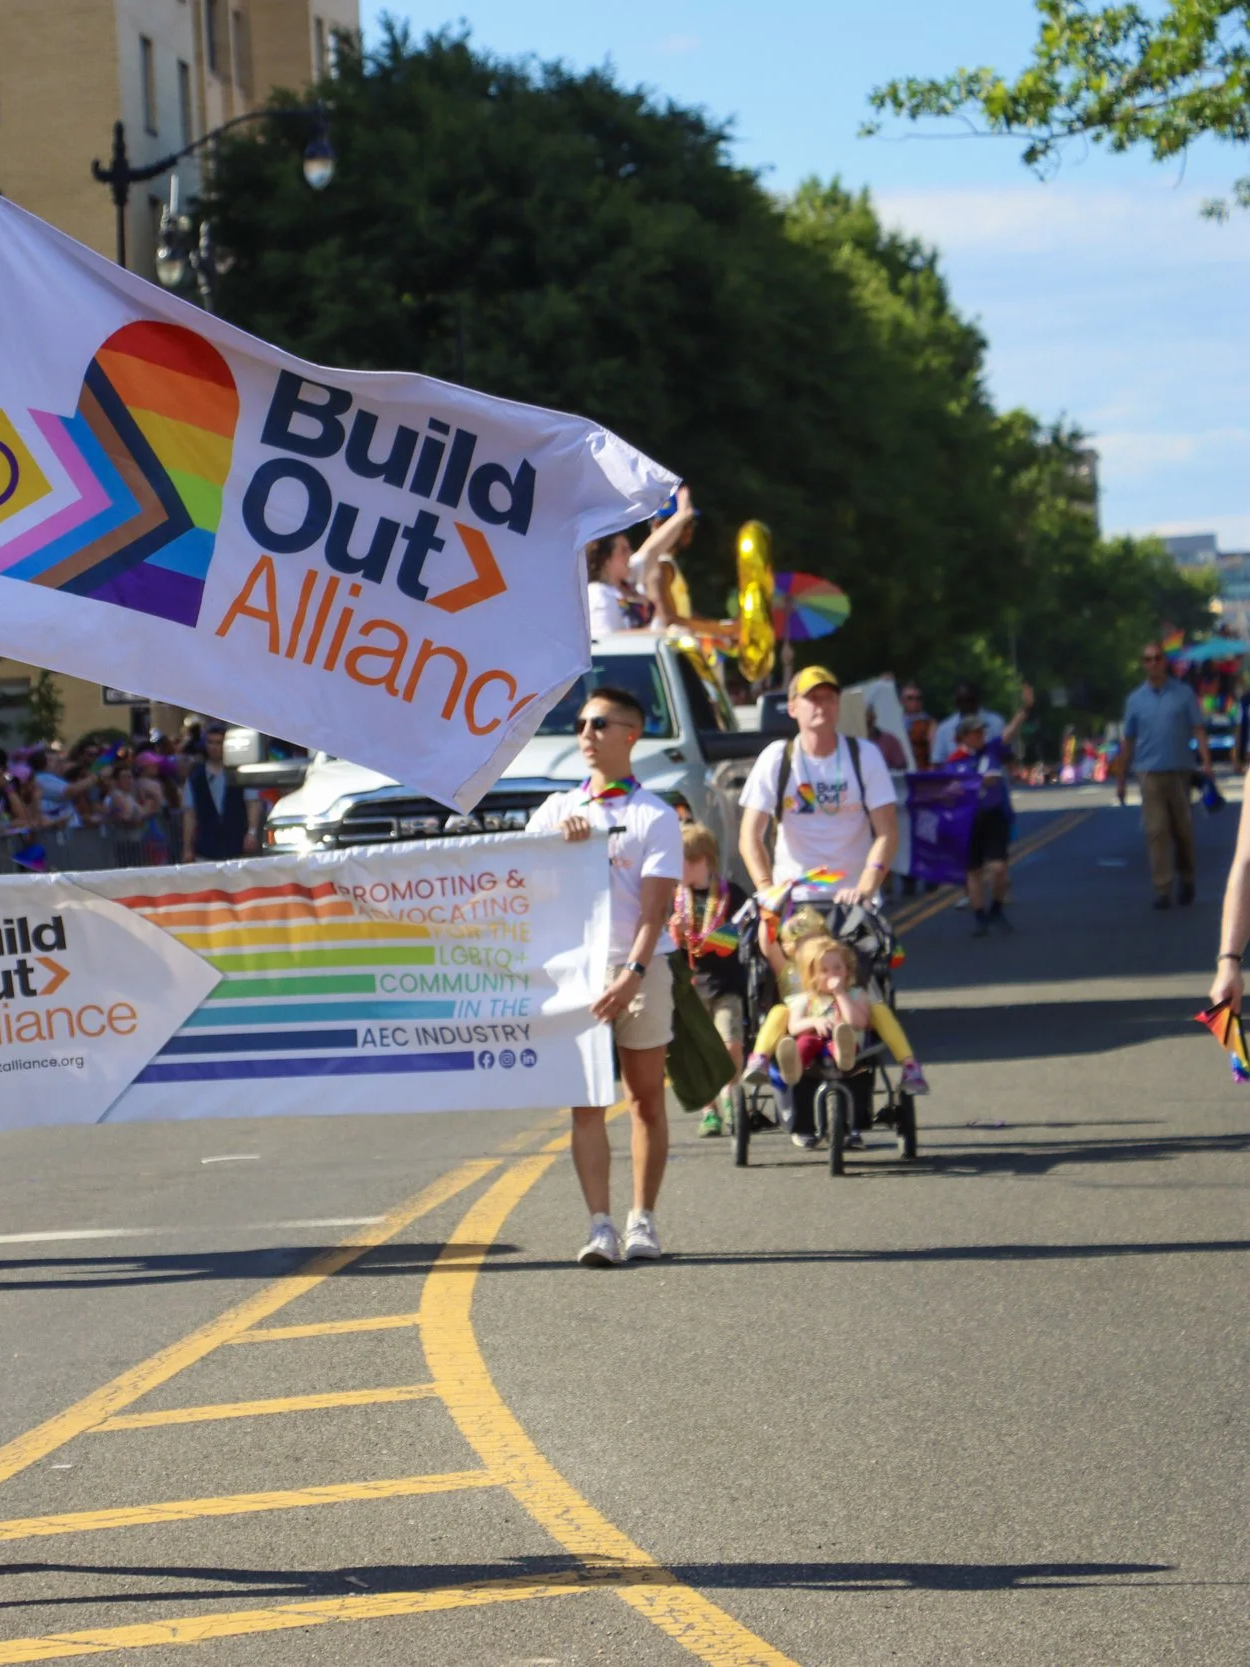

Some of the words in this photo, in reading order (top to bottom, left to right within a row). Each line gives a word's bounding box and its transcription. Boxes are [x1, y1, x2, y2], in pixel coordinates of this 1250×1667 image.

[261, 369, 537, 536] Build
[243, 457, 447, 603] Out
[337, 871, 498, 904] PROMOTING
[506, 868, 526, 889] &
[487, 920, 532, 944] THE
[439, 944, 530, 973] LGBTQ+
[379, 972, 531, 994] COMMUNITY
[456, 1000, 482, 1019] IN
[490, 998, 531, 1018] THE
[361, 1027, 410, 1049] AEC
[415, 1023, 531, 1047] INDUSTRY
